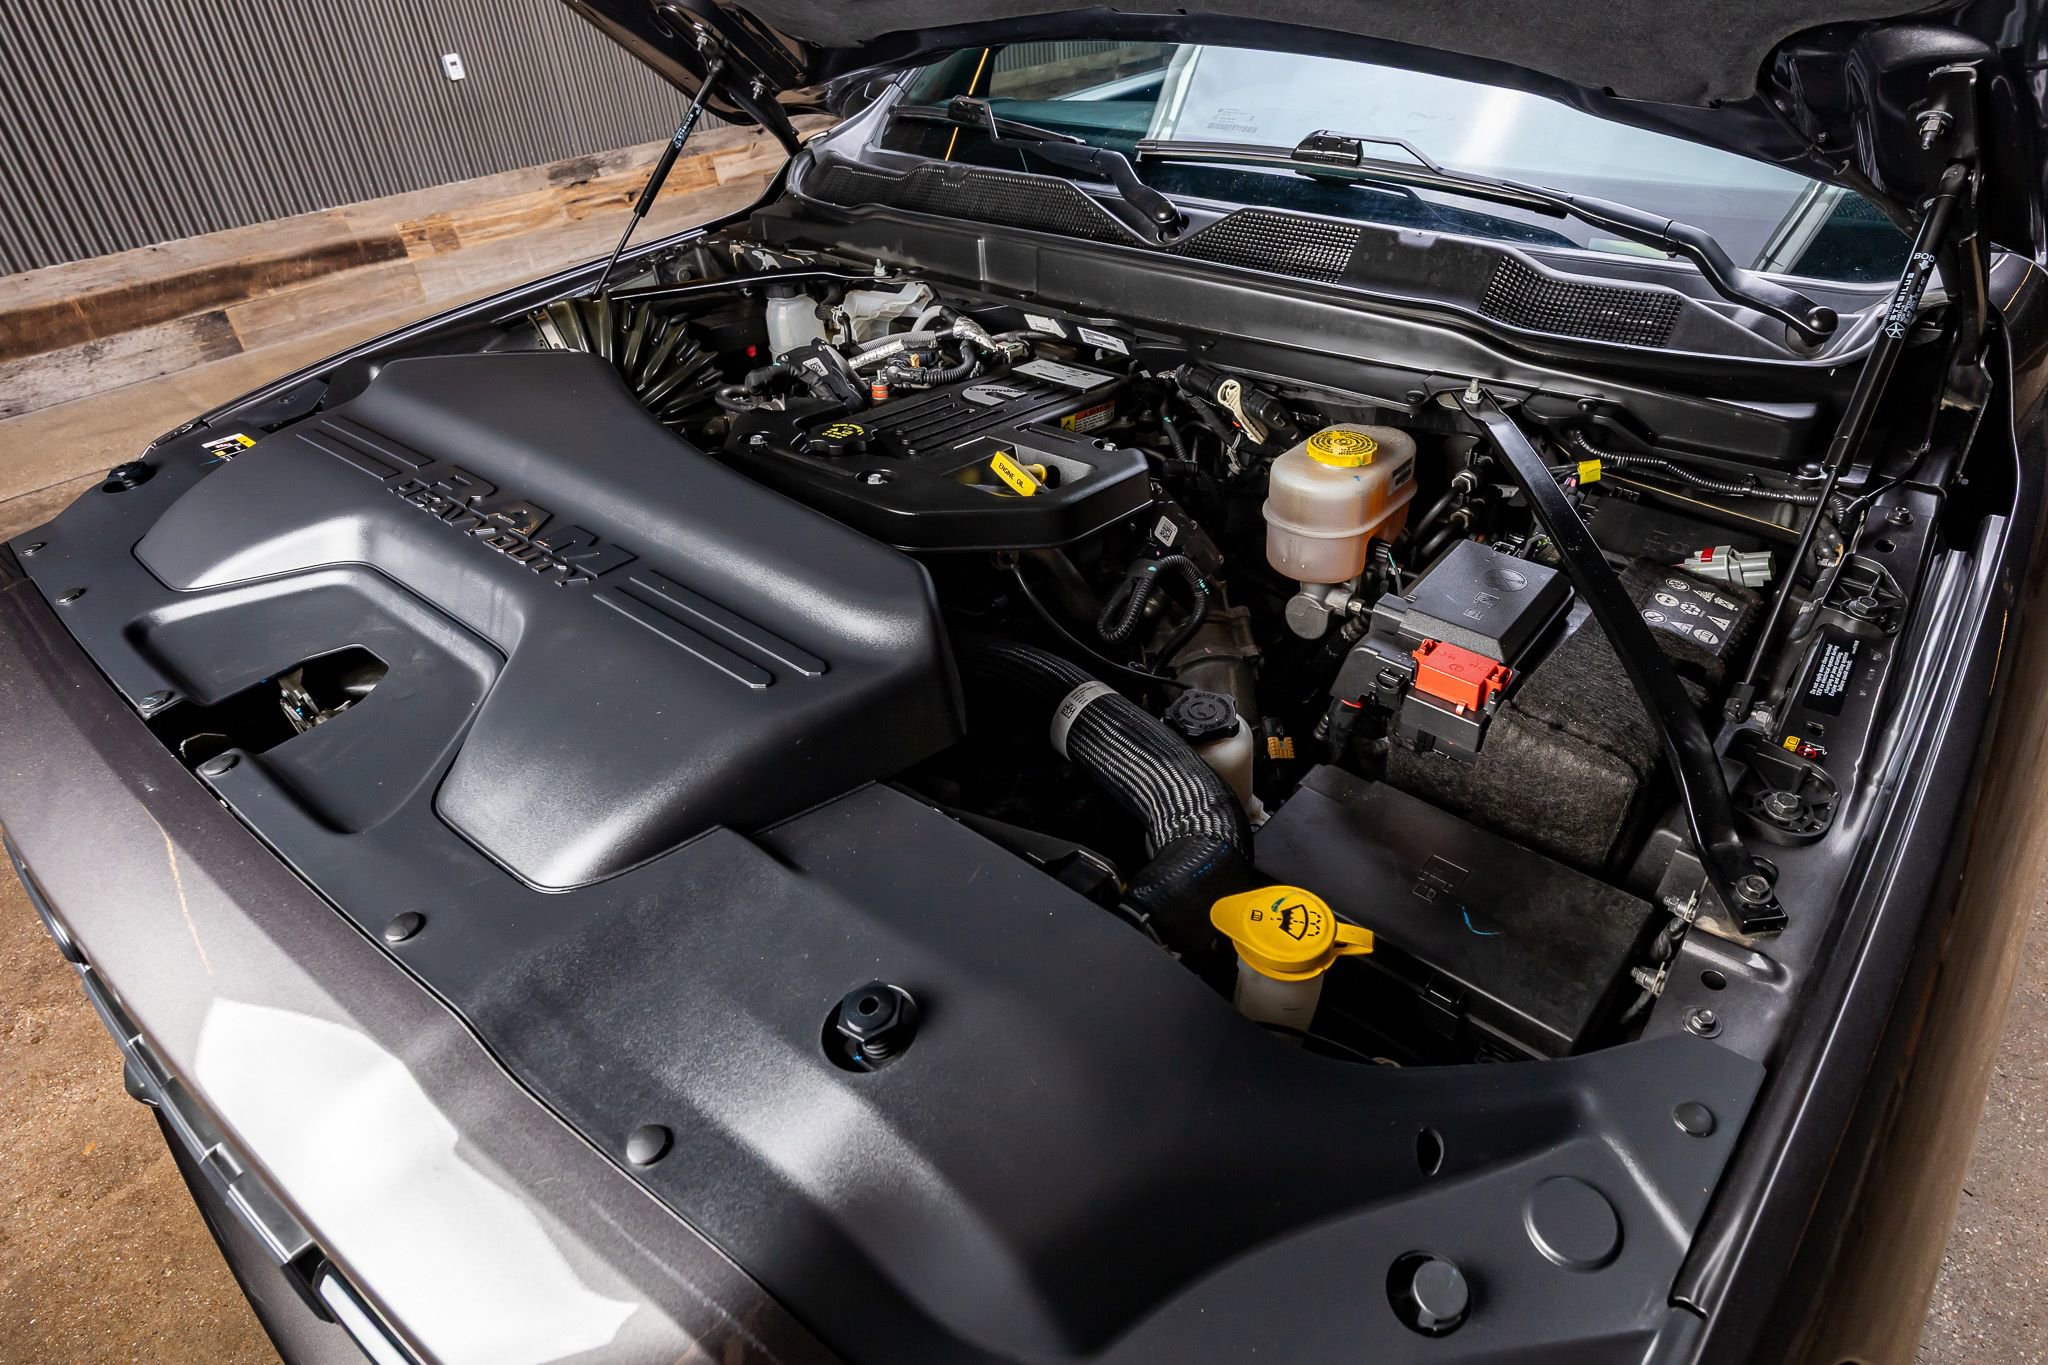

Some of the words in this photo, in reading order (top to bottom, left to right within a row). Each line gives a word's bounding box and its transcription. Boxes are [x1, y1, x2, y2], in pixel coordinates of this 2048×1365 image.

[1889, 272, 1915, 321] STABILUS
[998, 462, 1015, 480] ENGINE
[1016, 478, 1024, 488] OIL
[387, 478, 497, 537] HEAVY
[482, 534, 592, 587] DUTY
[413, 465, 639, 578] RAM
